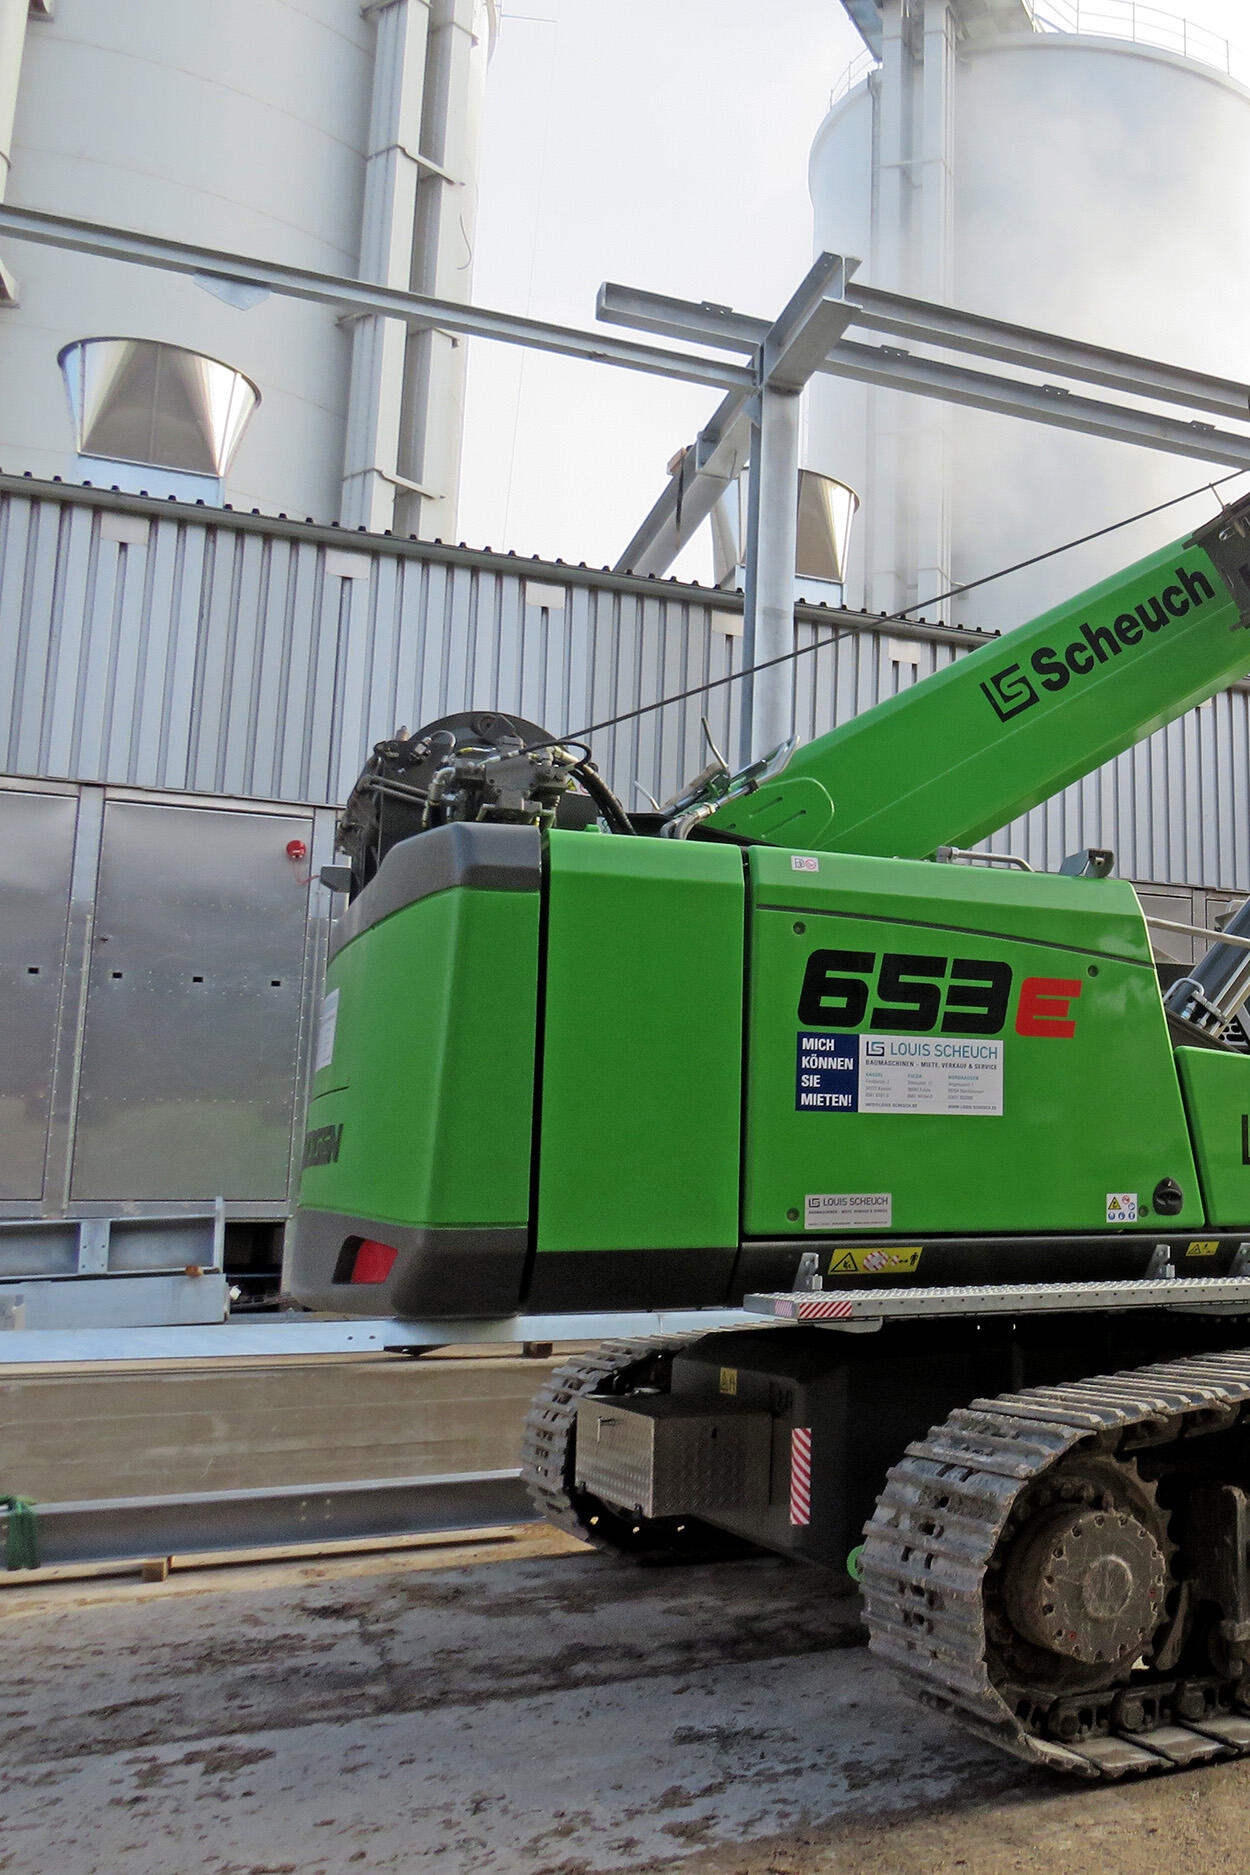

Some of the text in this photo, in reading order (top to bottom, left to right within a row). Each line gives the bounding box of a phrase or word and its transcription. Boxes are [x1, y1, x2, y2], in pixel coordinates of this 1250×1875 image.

[1030, 566, 1216, 692] Scheuch
[802, 1038, 835, 1052] MICH
[890, 1042, 931, 1057] LOUIS
[934, 1044, 998, 1060] SCHEUCH
[801, 1054, 854, 1070] KÖNNEN
[865, 1059, 914, 1067] BAUMASCHINEN
[801, 1074, 821, 1088] SIE
[800, 1093, 852, 1107] MIETEN!
[823, 1197, 848, 1206] LOUIS
[849, 1196, 889, 1206] SCHEUCH
